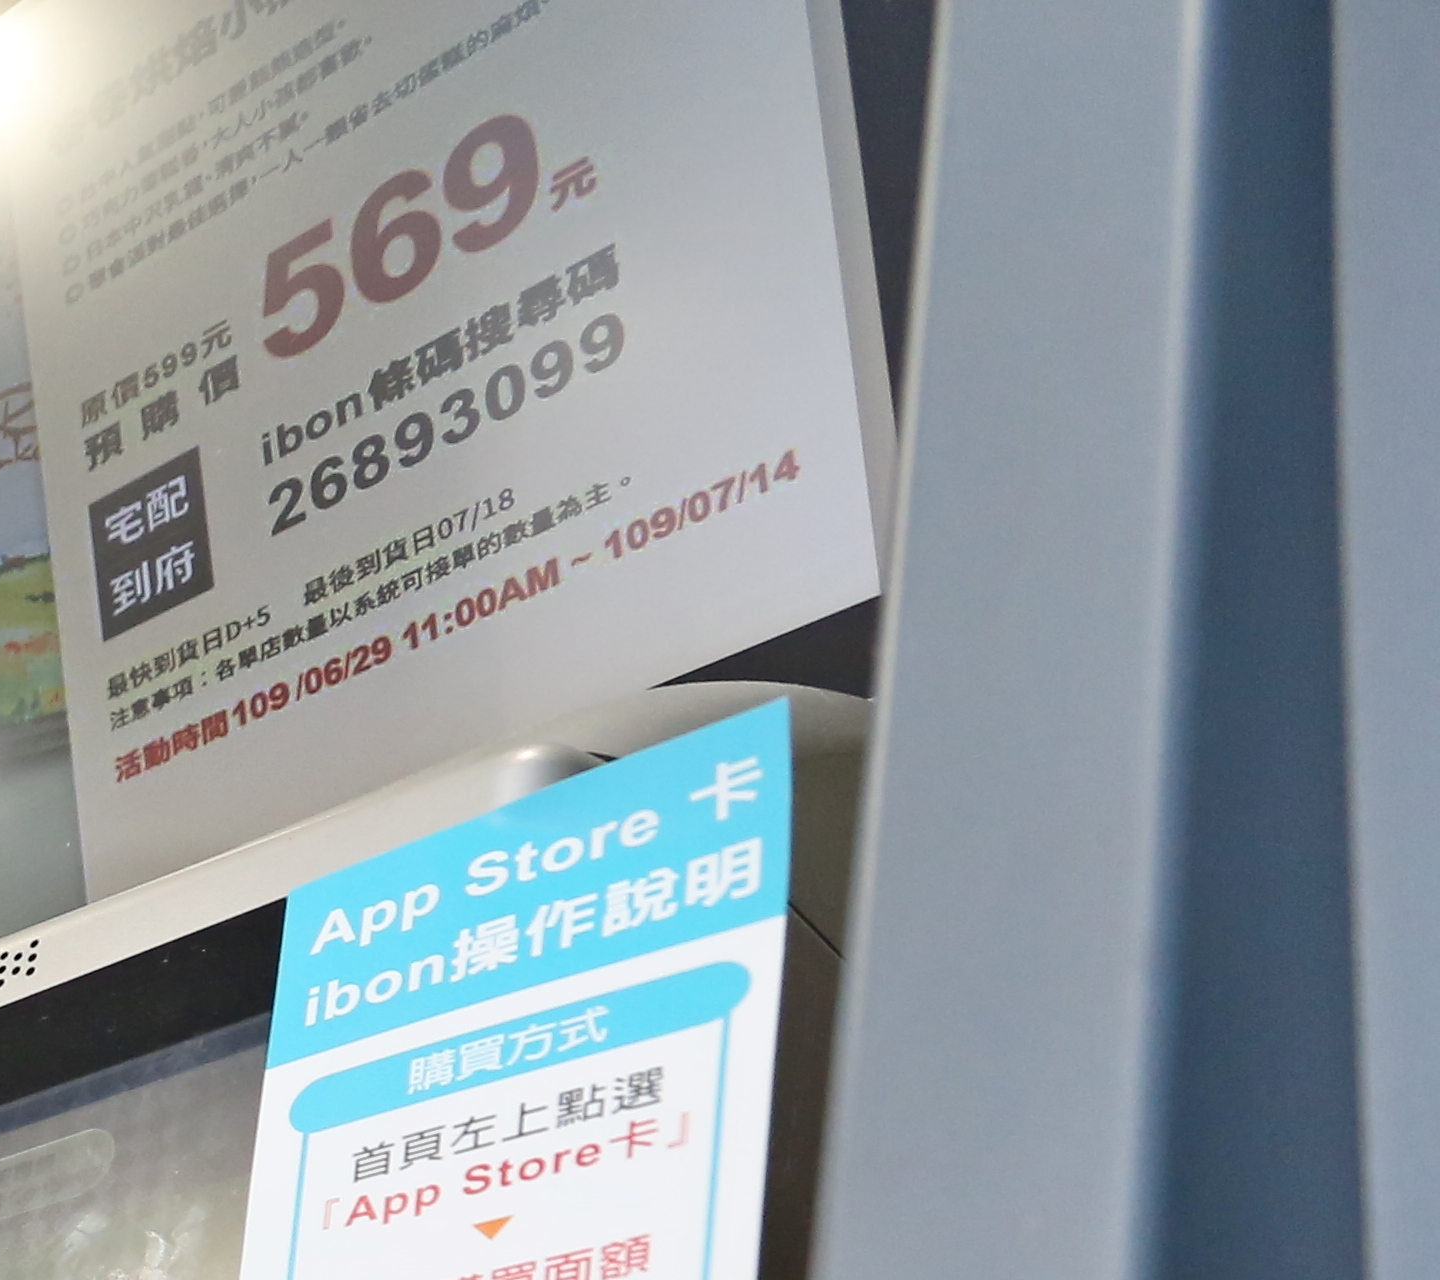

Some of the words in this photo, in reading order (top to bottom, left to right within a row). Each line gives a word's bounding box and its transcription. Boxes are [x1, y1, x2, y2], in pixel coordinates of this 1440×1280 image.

[81, 318, 234, 427] 原價599元
[261, 243, 621, 469] ibon條碼搜尋碼
[268, 312, 628, 538] 26893099
[103, 474, 190, 548] 宅配
[106, 607, 272, 701] 最快到貨日D+5
[302, 487, 516, 607] 最後到貨日07/18
[108, 542, 195, 616] 到府
[401, 558, 563, 661] 11:00AM
[603, 449, 801, 563] 109/07/14
[304, 837, 763, 1027] ibon操作說明
[308, 881, 440, 955] App
[465, 807, 660, 898] Store
[689, 756, 764, 821] 卡
[351, 1066, 665, 1184] 首頁左上點選
[407, 1004, 609, 1094] 購買方式
